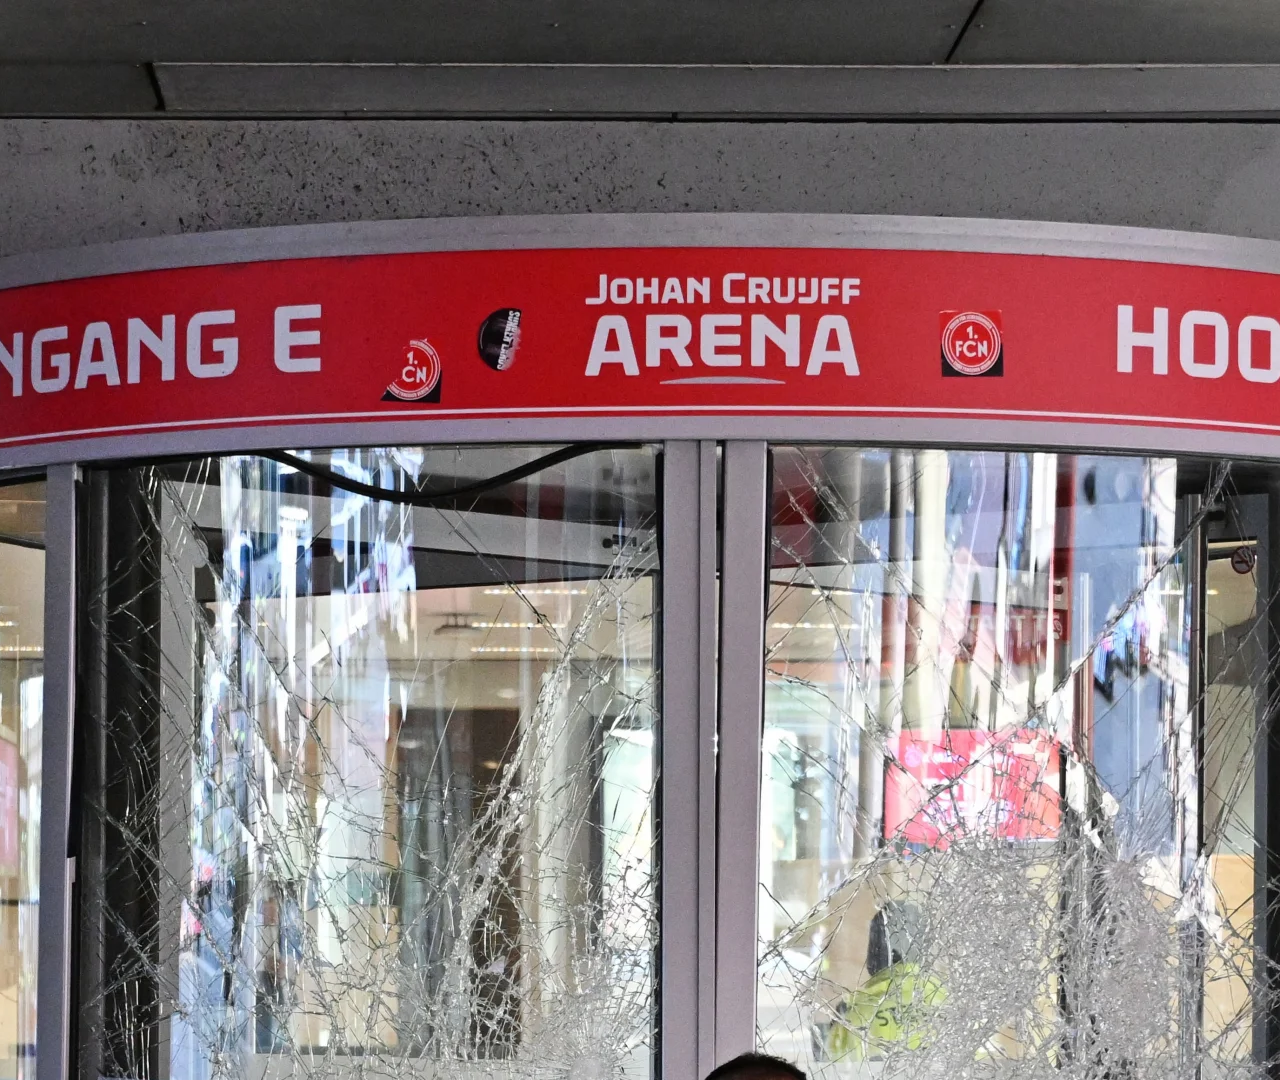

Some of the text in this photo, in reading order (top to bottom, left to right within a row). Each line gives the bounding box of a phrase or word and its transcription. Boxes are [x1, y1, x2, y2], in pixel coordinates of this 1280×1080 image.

[585, 273, 711, 305] JOHAN
[273, 303, 322, 374] E
[584, 314, 861, 376] ARENA
[955, 340, 988, 358] FCN
[402, 366, 427, 383] CN
